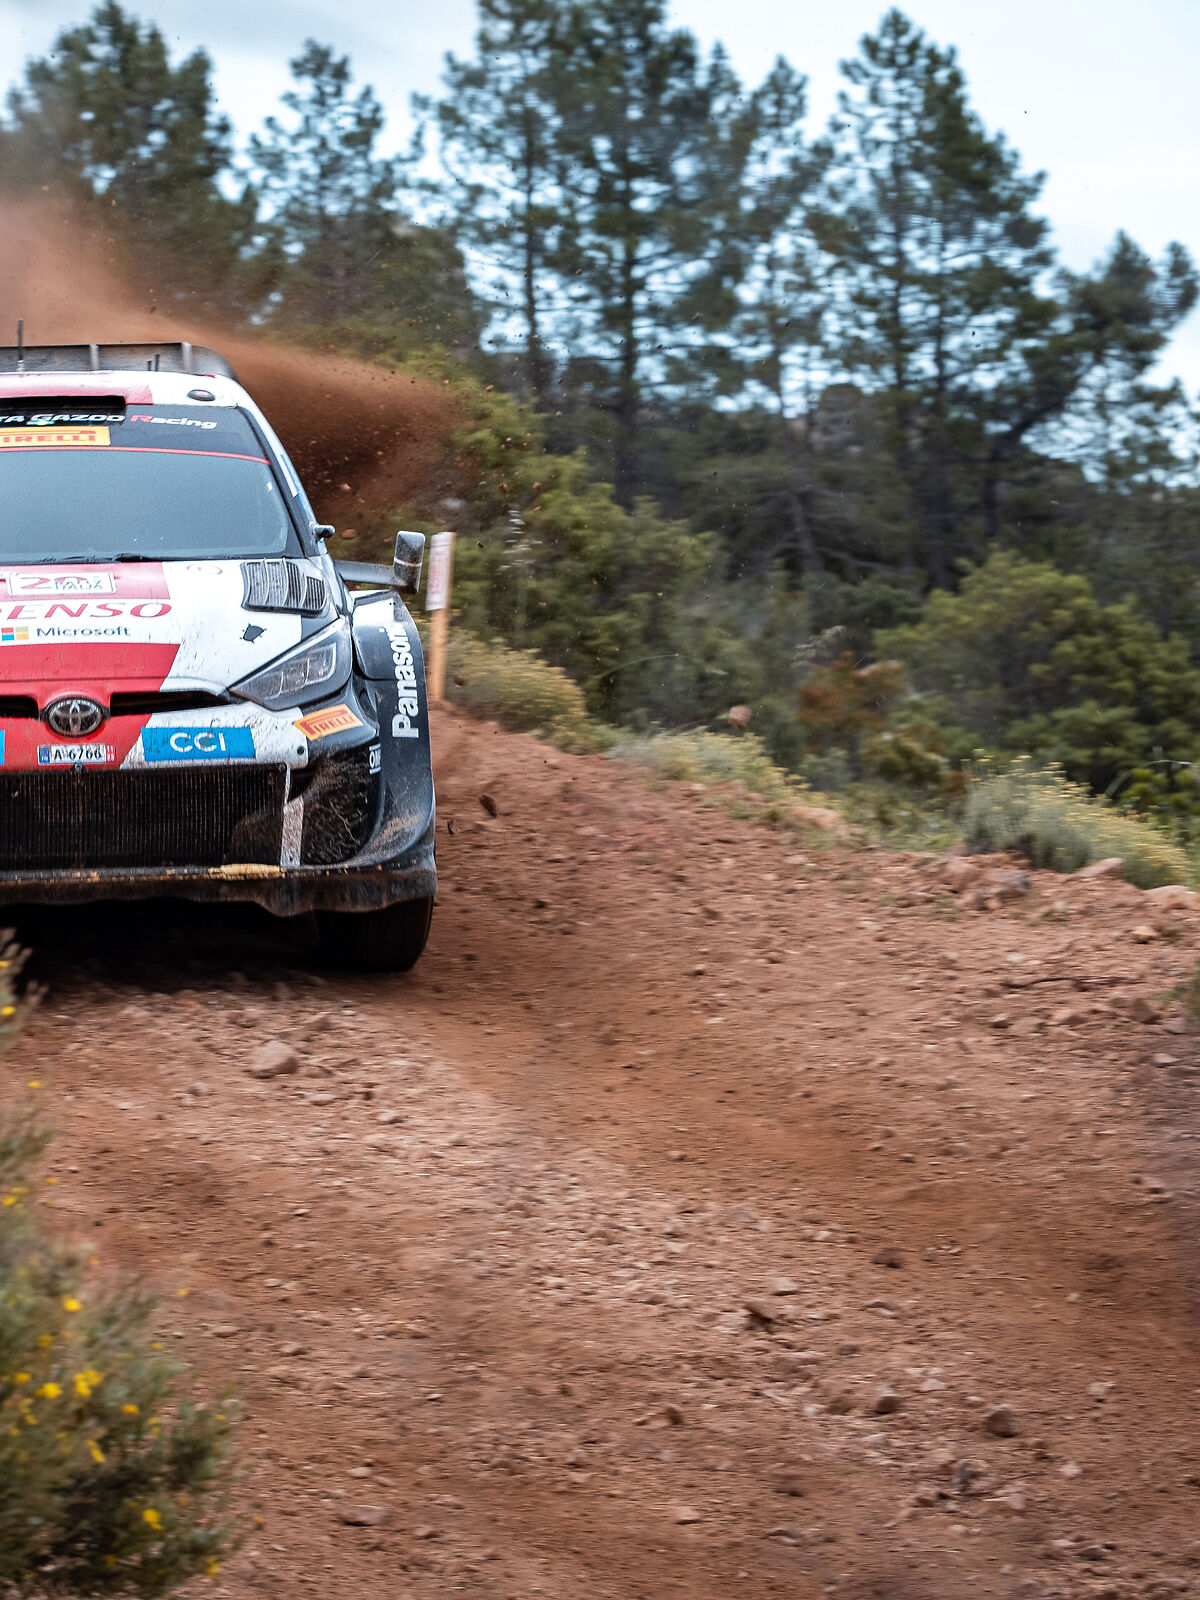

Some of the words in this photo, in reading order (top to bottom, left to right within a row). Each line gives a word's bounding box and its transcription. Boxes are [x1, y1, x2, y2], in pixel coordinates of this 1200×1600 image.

[30, 413, 126, 423] GAZOO
[130, 414, 218, 430] Racing
[36, 626, 131, 637] Microsoft
[379, 621, 419, 738] Panasoni
[302, 708, 356, 735] PIRELLI
[169, 732, 226, 752] CCI
